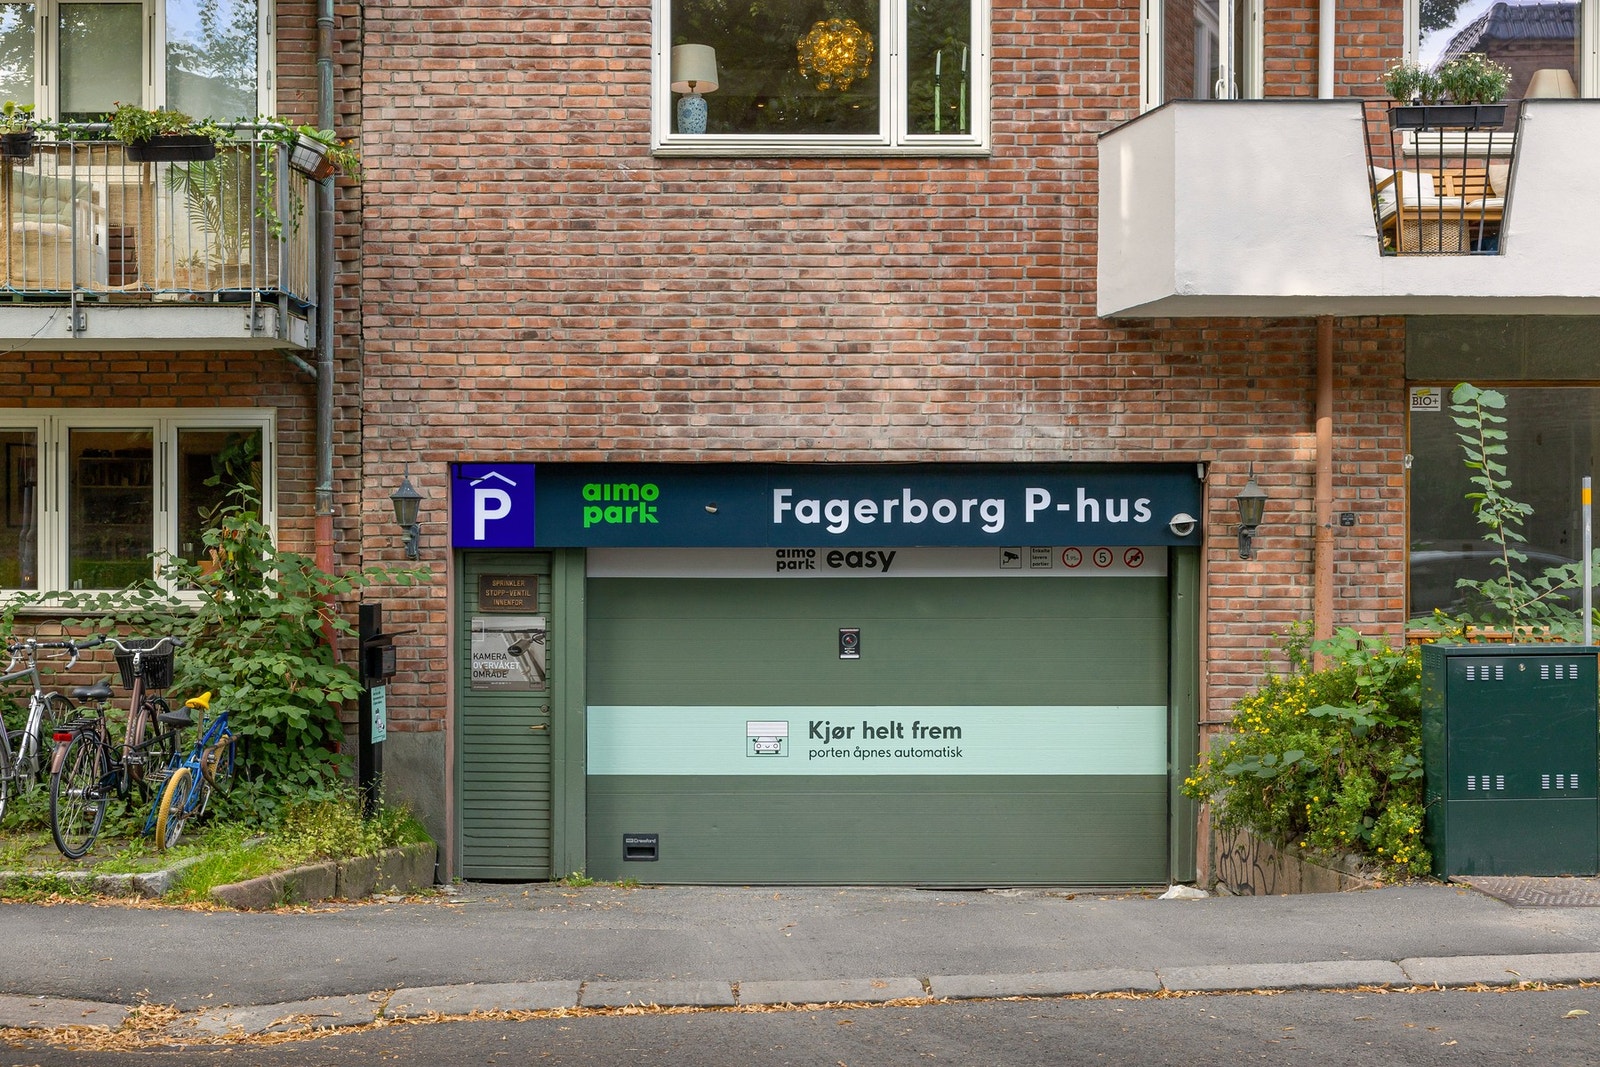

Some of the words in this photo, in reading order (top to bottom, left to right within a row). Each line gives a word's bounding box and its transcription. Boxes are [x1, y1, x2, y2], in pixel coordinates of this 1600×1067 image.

[1412, 396, 1439, 406] BIO+
[582, 483, 660, 502] aimo
[474, 488, 512, 541] P
[583, 502, 660, 528] park
[773, 488, 1006, 534] Fagerborg
[1025, 487, 1152, 523] P-hus
[775, 548, 816, 558] aimo
[1099, 552, 1107, 564] 5
[776, 558, 816, 572] park
[826, 549, 897, 573] easy
[485, 589, 531, 597] STOPP-VENTIL
[473, 661, 520, 669] OVERVÅKET
[808, 720, 855, 744] Kjør
[862, 720, 904, 739] helt
[911, 720, 962, 739] frem
[809, 747, 850, 760] porten
[853, 746, 891, 760] åpnes
[894, 746, 963, 758] automatisk
